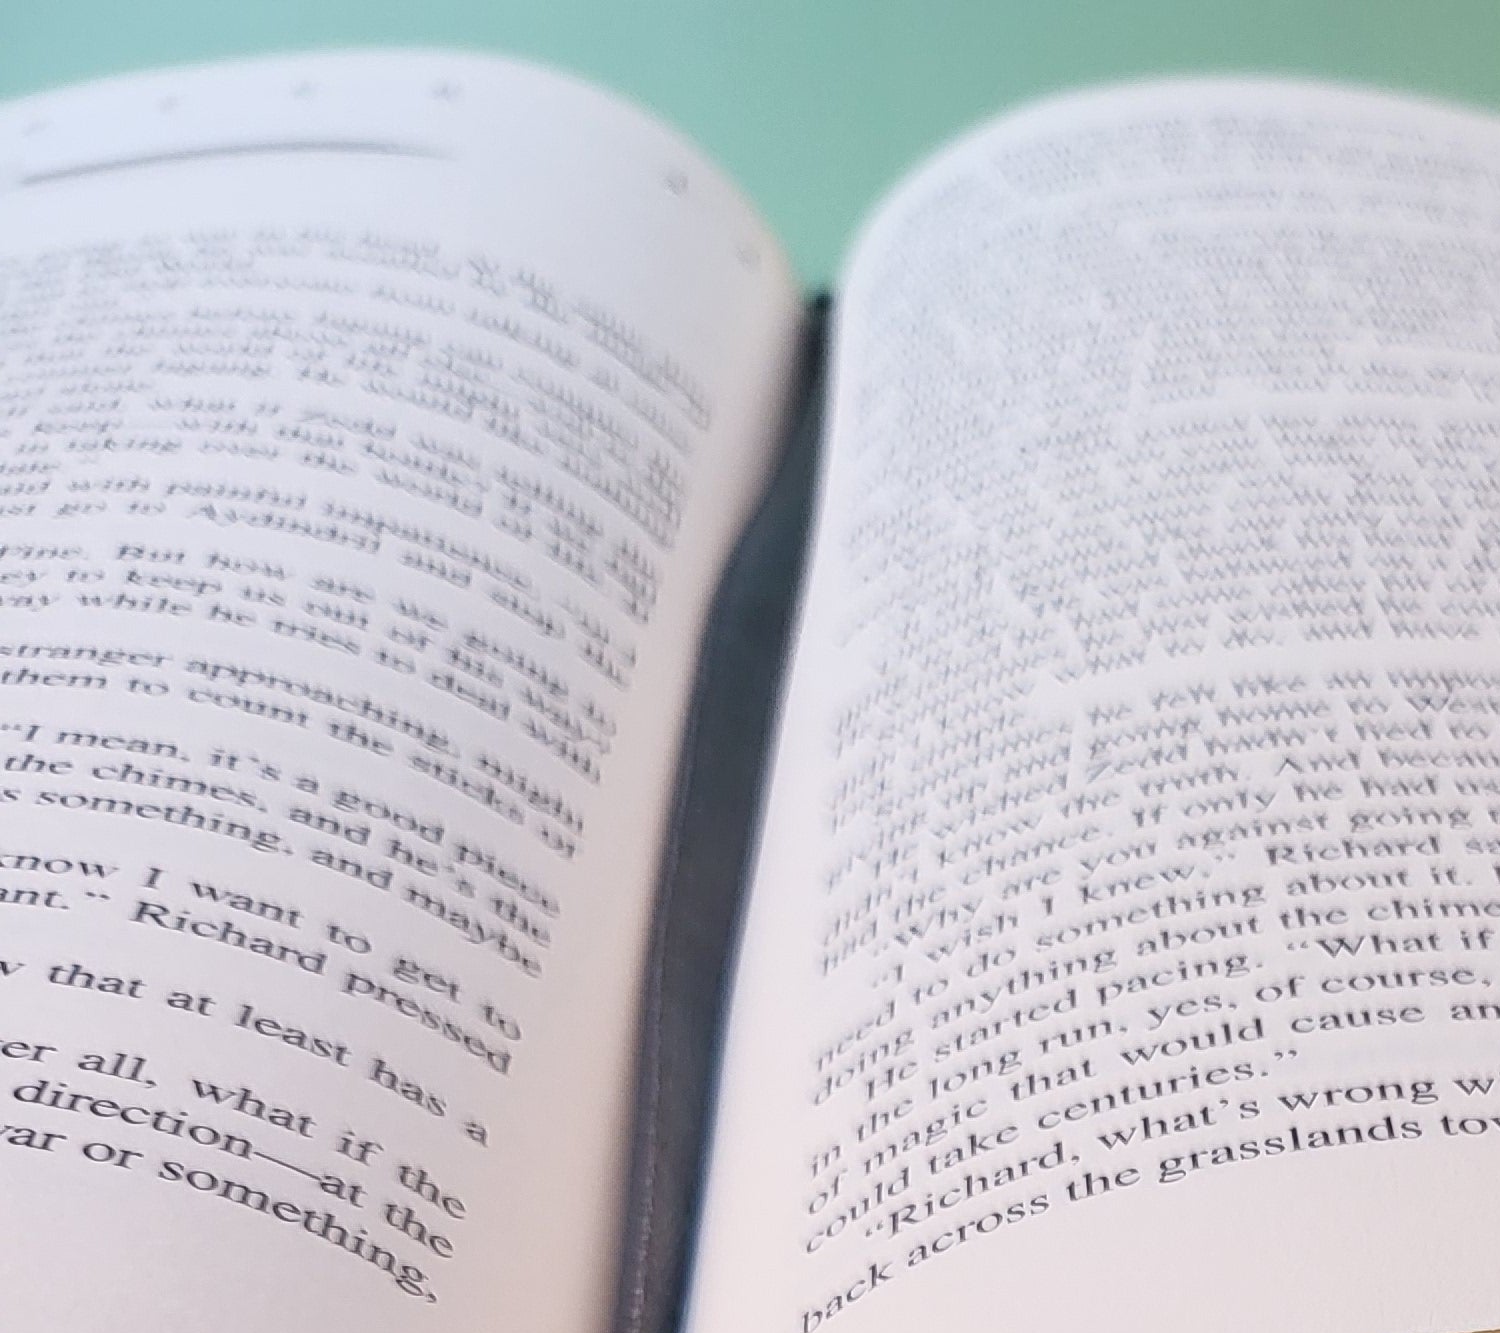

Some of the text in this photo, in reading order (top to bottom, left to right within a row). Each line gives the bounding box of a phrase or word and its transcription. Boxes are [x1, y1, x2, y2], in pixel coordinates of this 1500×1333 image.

[33, 790, 295, 855] something,
[309, 848, 393, 890] and
[404, 885, 544, 971] maybe
[141, 865, 165, 889] I
[190, 881, 302, 928] want
[324, 923, 373, 954] to
[391, 956, 464, 1002] get
[478, 1003, 523, 1041] to
[48, 962, 489, 1147] that at least has a
[127, 899, 328, 975] Richard
[338, 970, 511, 1074] pressed
[809, 1143, 842, 1177] in
[855, 1098, 915, 1142] the
[928, 1049, 1021, 1100] long
[1037, 1019, 1128, 1054] run,
[1147, 993, 1239, 1031] yes,
[1254, 975, 1304, 1001] of
[1319, 968, 1492, 993] course,
[811, 1027, 917, 1105] doing
[929, 949, 1117, 1029] anything
[1135, 914, 1262, 956] about
[1278, 906, 1349, 929] the
[864, 1060, 919, 1100] He
[932, 987, 1078, 1062] started
[1095, 954, 1264, 1007] pacing.
[1459, 927, 1496, 950] if
[0, 1038, 467, 1220] er all, what if the
[804, 1165, 911, 1253] could
[927, 1124, 1020, 1175] take
[807, 1168, 849, 1215] of
[863, 1098, 989, 1175] magic
[1009, 1058, 1096, 1101] that
[1119, 1016, 1265, 1065] would
[1289, 1005, 1426, 1033] cause
[864, 1140, 1082, 1237] "Richard,
[1096, 1097, 1262, 1150] what's
[1277, 1080, 1440, 1111] wrong
[906, 1193, 1051, 1267] across
[1065, 1167, 1142, 1201] the
[1158, 1114, 1424, 1184] grasslands
[82, 1141, 144, 1169] or
[157, 1159, 439, 1303] something,
[383, 1202, 455, 1258] the
